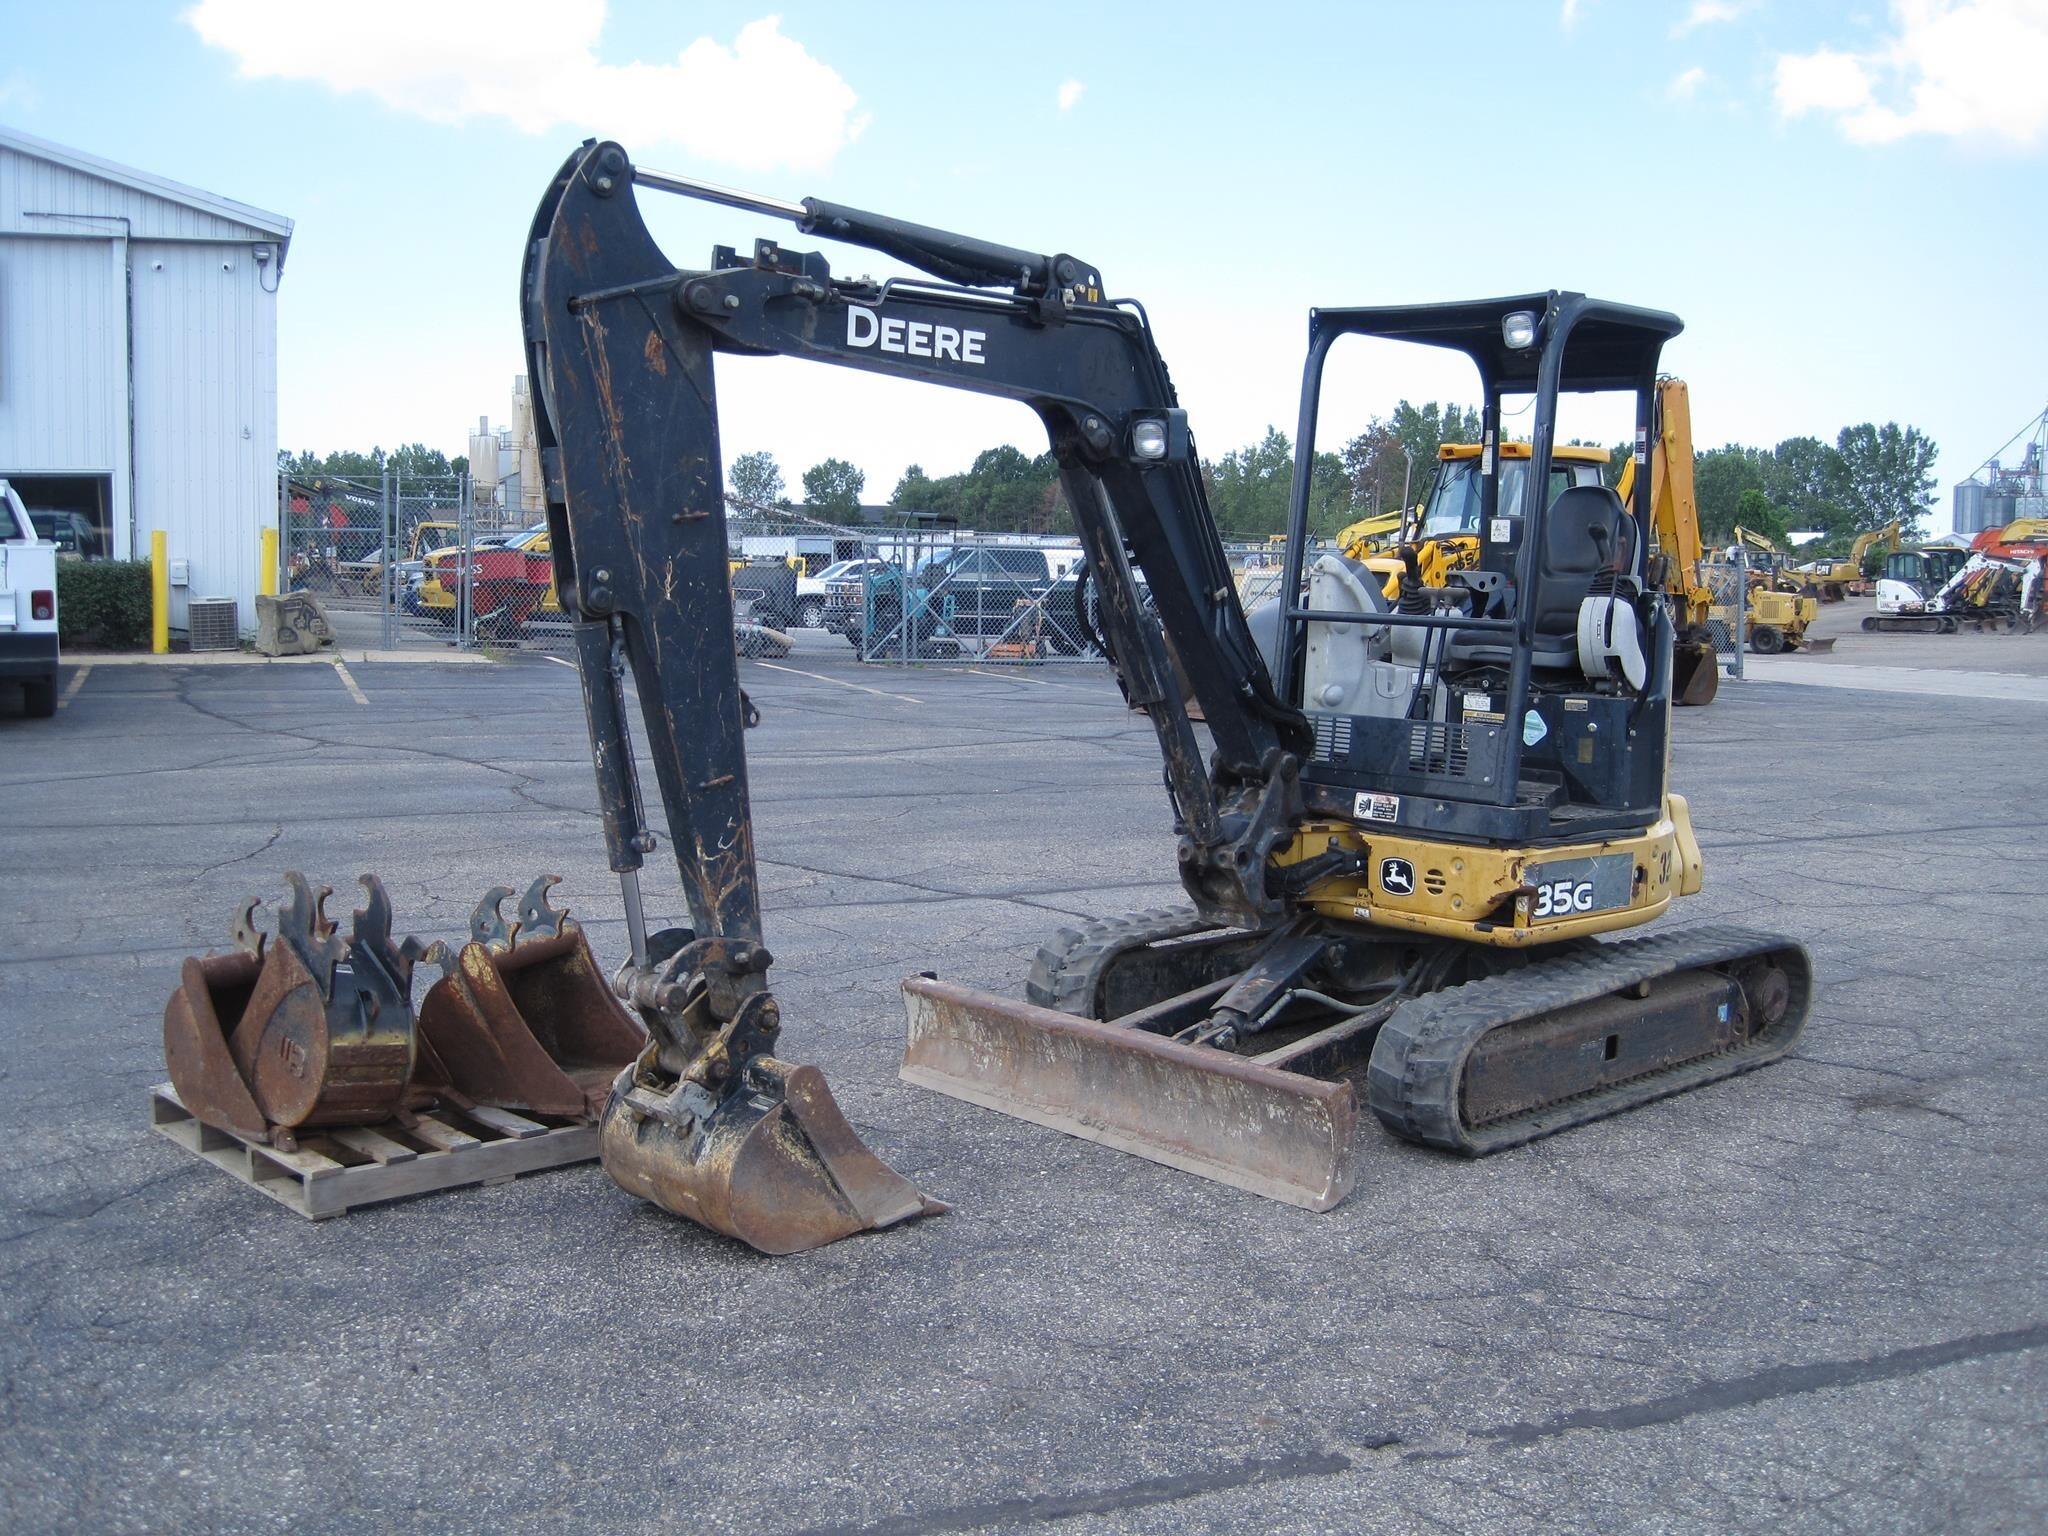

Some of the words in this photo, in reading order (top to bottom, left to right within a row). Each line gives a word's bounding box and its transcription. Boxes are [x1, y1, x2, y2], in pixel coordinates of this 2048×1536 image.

[847, 305, 986, 364] DEERE
[345, 493, 376, 507] VOLVO
[1816, 564, 1830, 574] CAT
[1533, 881, 1593, 916] 35G
